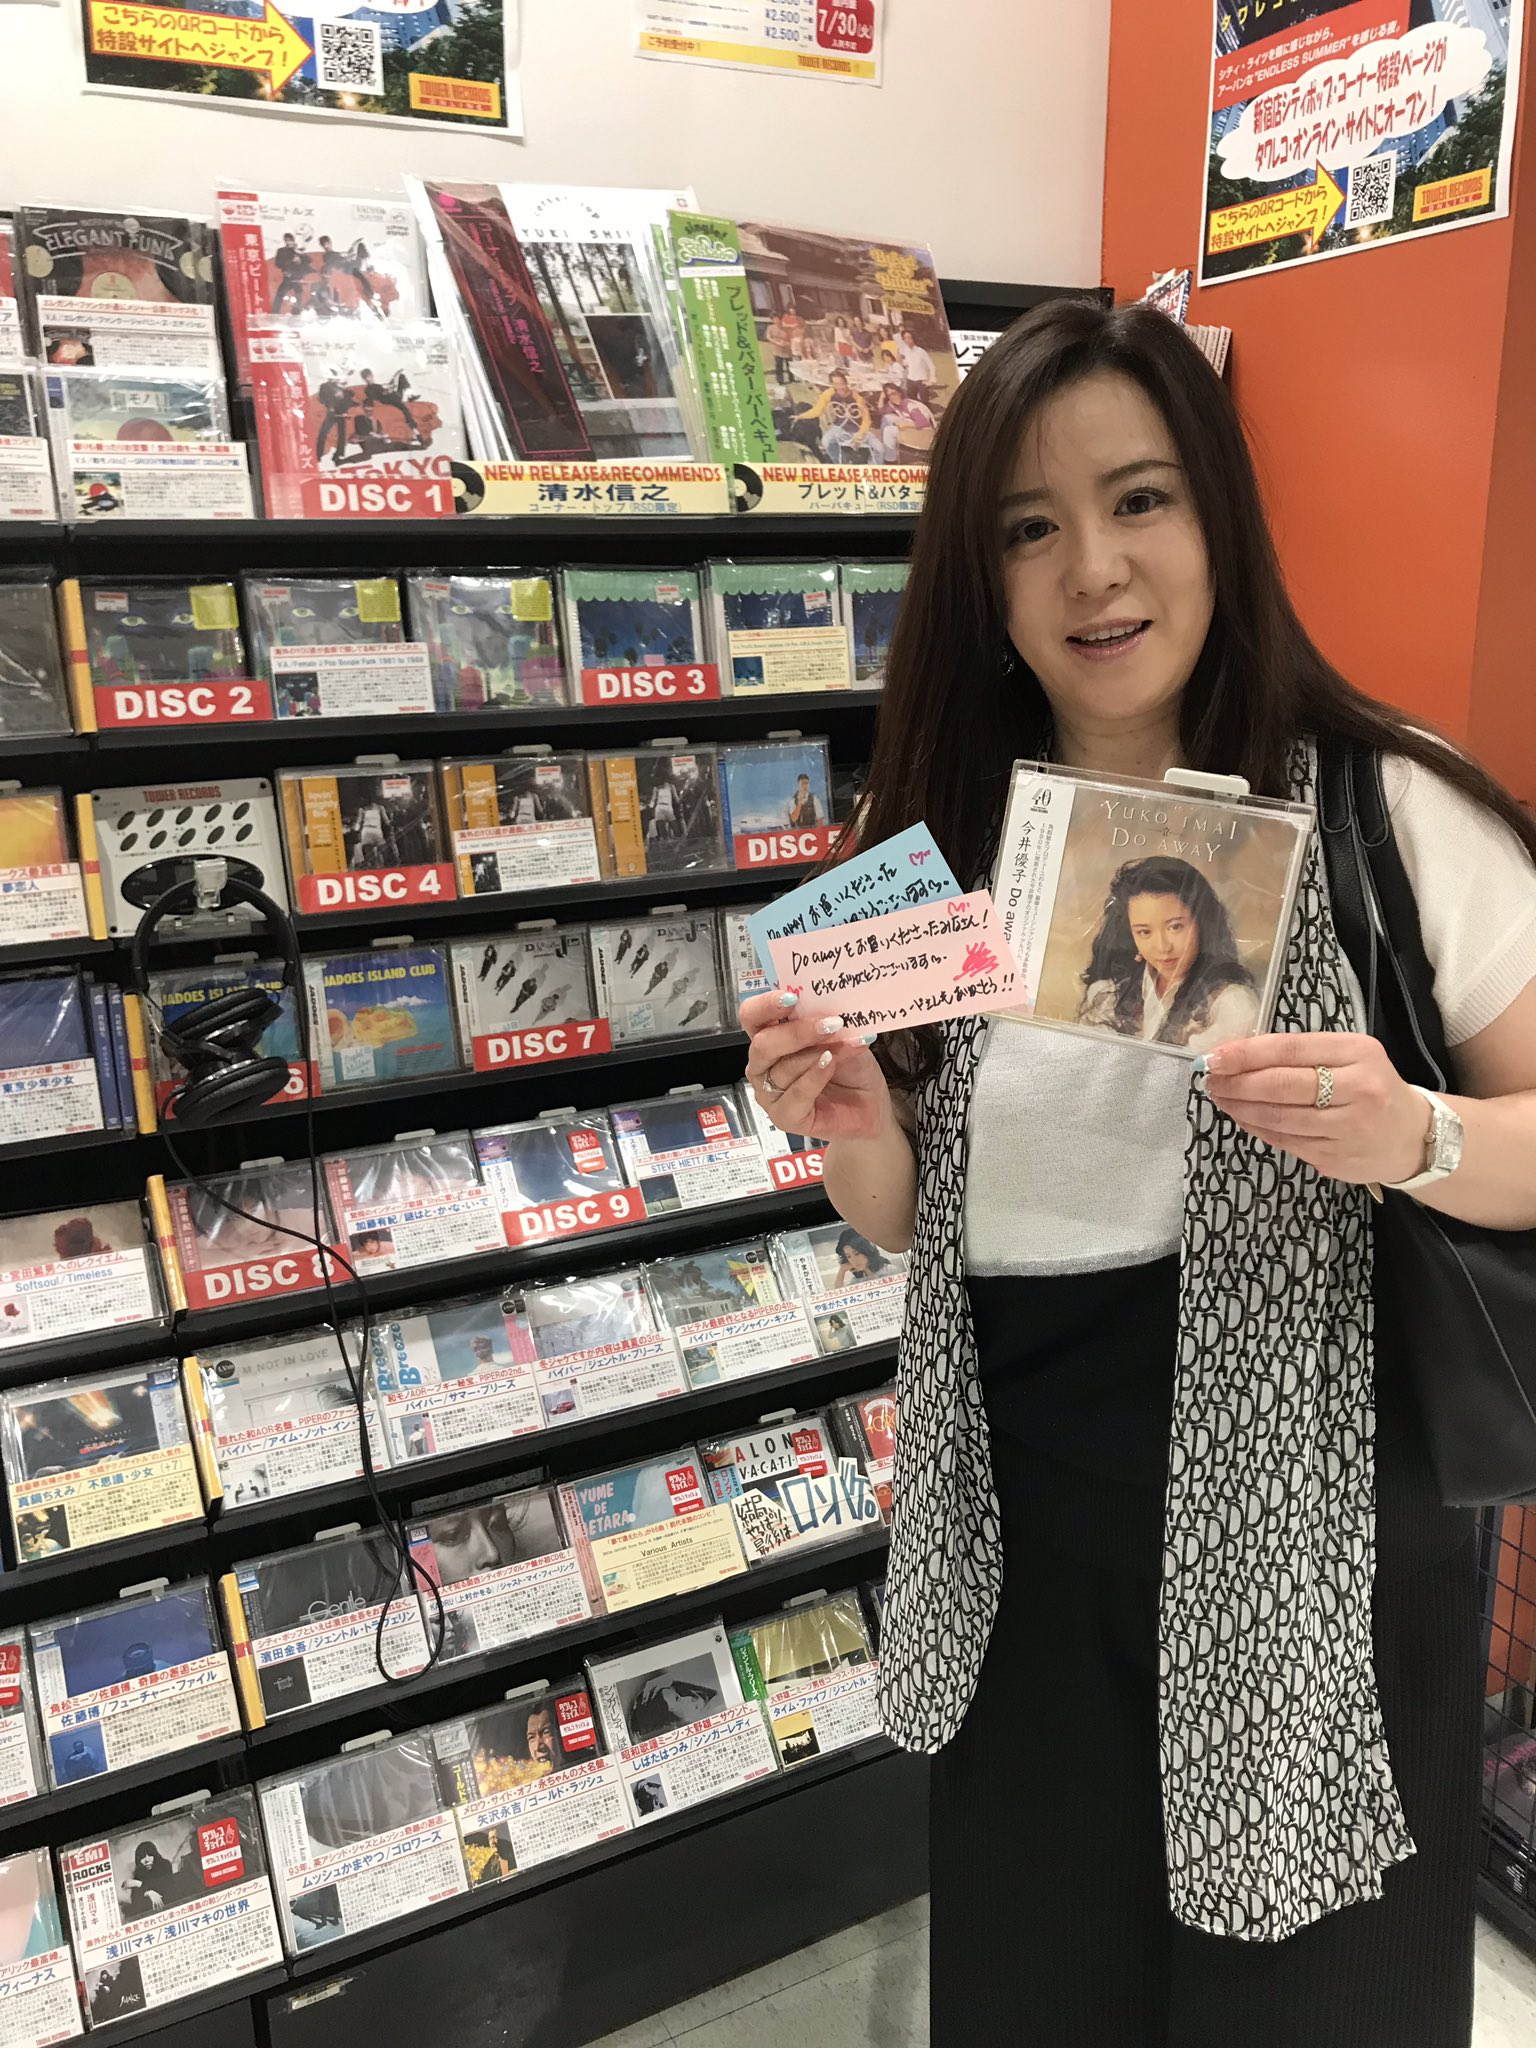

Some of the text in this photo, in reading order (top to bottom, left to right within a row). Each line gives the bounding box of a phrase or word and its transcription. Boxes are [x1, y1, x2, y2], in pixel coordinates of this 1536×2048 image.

[102, 6, 286, 44] こちらのQRコードから
[1422, 175, 1483, 205] TOWER RECORDS
[1217, 186, 1327, 227] こちらのQRコードから
[1210, 206, 1327, 248] 特設サイトへジャンプ！
[46, 228, 176, 260] ELEGANT FUNK
[484, 465, 722, 484] NEW RELEASE&RECOMMENDS
[763, 467, 797, 482] NEW
[319, 483, 442, 512] DISC 1
[538, 483, 670, 502] 清水信之
[599, 669, 706, 698] DISC 3
[114, 686, 254, 721] DISC 2
[1183, 817, 1238, 840] IMAI
[748, 833, 818, 862] DISC
[1012, 820, 1036, 884] 今井優子
[318, 871, 441, 906] DISC 4
[1008, 888, 1022, 908] Do
[324, 964, 436, 987] JADOES ISLAND CLUB
[791, 951, 809, 975] Do
[162, 990, 205, 1006] JADOES
[460, 964, 469, 1004] JADOES
[309, 985, 319, 1025] JADOES
[488, 1025, 597, 1063] DISC 7
[2, 1075, 75, 1094] 東京少年少女
[284, 1068, 304, 1094] 6
[651, 1159, 677, 1174] STEVE
[519, 1194, 630, 1237] DISC 9
[15, 1268, 113, 1292] Softsoul/Timeless
[205, 1253, 335, 1299] DISC 8
[300, 1348, 329, 1363] LOVE
[391, 1323, 422, 1385] Breeze
[538, 1333, 664, 1370] 冬ジャケですが内容は真夏の3rd。
[160, 1459, 184, 1473] (+7)
[735, 1446, 746, 1463] A
[580, 1482, 614, 1504] YUME
[594, 1502, 606, 1514] DE
[641, 1545, 668, 1557] Various
[671, 1537, 694, 1549] Artists
[427, 1550, 571, 1599] 知人ぞ知る関西シティポップのレア盤が初CD化！
[299, 1590, 366, 1624] Gentle
[61, 1671, 217, 1728] 佐藤博/フューチャー・ファイル
[559, 1700, 577, 1713] タワレコ
[603, 1685, 624, 1731] シンガーレディ
[562, 1709, 580, 1721] チョイス
[621, 1705, 753, 1760] 昭和歌謡ミーツ・大野雄二サウンド。
[632, 1718, 751, 1771] しばたはつみ/シンガーレディ
[463, 1759, 609, 1814] メロウ・サイド・オブ・永ちゃんの大名盤。
[477, 1776, 604, 1827] 矢沢永吉/ゴールド・ラッシュ
[201, 1827, 225, 1842] タワレコ
[204, 1838, 227, 1851] チョイス
[288, 1815, 447, 1877] 93年、英アシッド・ジャズとムッシュ奇跡の邂逅。
[75, 1847, 103, 1865] EMI
[302, 1829, 443, 1889] ムッシュかまやつ/ゴロワーズ
[73, 1862, 112, 1881] ROCKS
[75, 1877, 113, 1894] The First
[86, 1892, 99, 1925] 浅川マキ
[105, 1898, 250, 1961] 浅川マキ/浅川マキの世界
